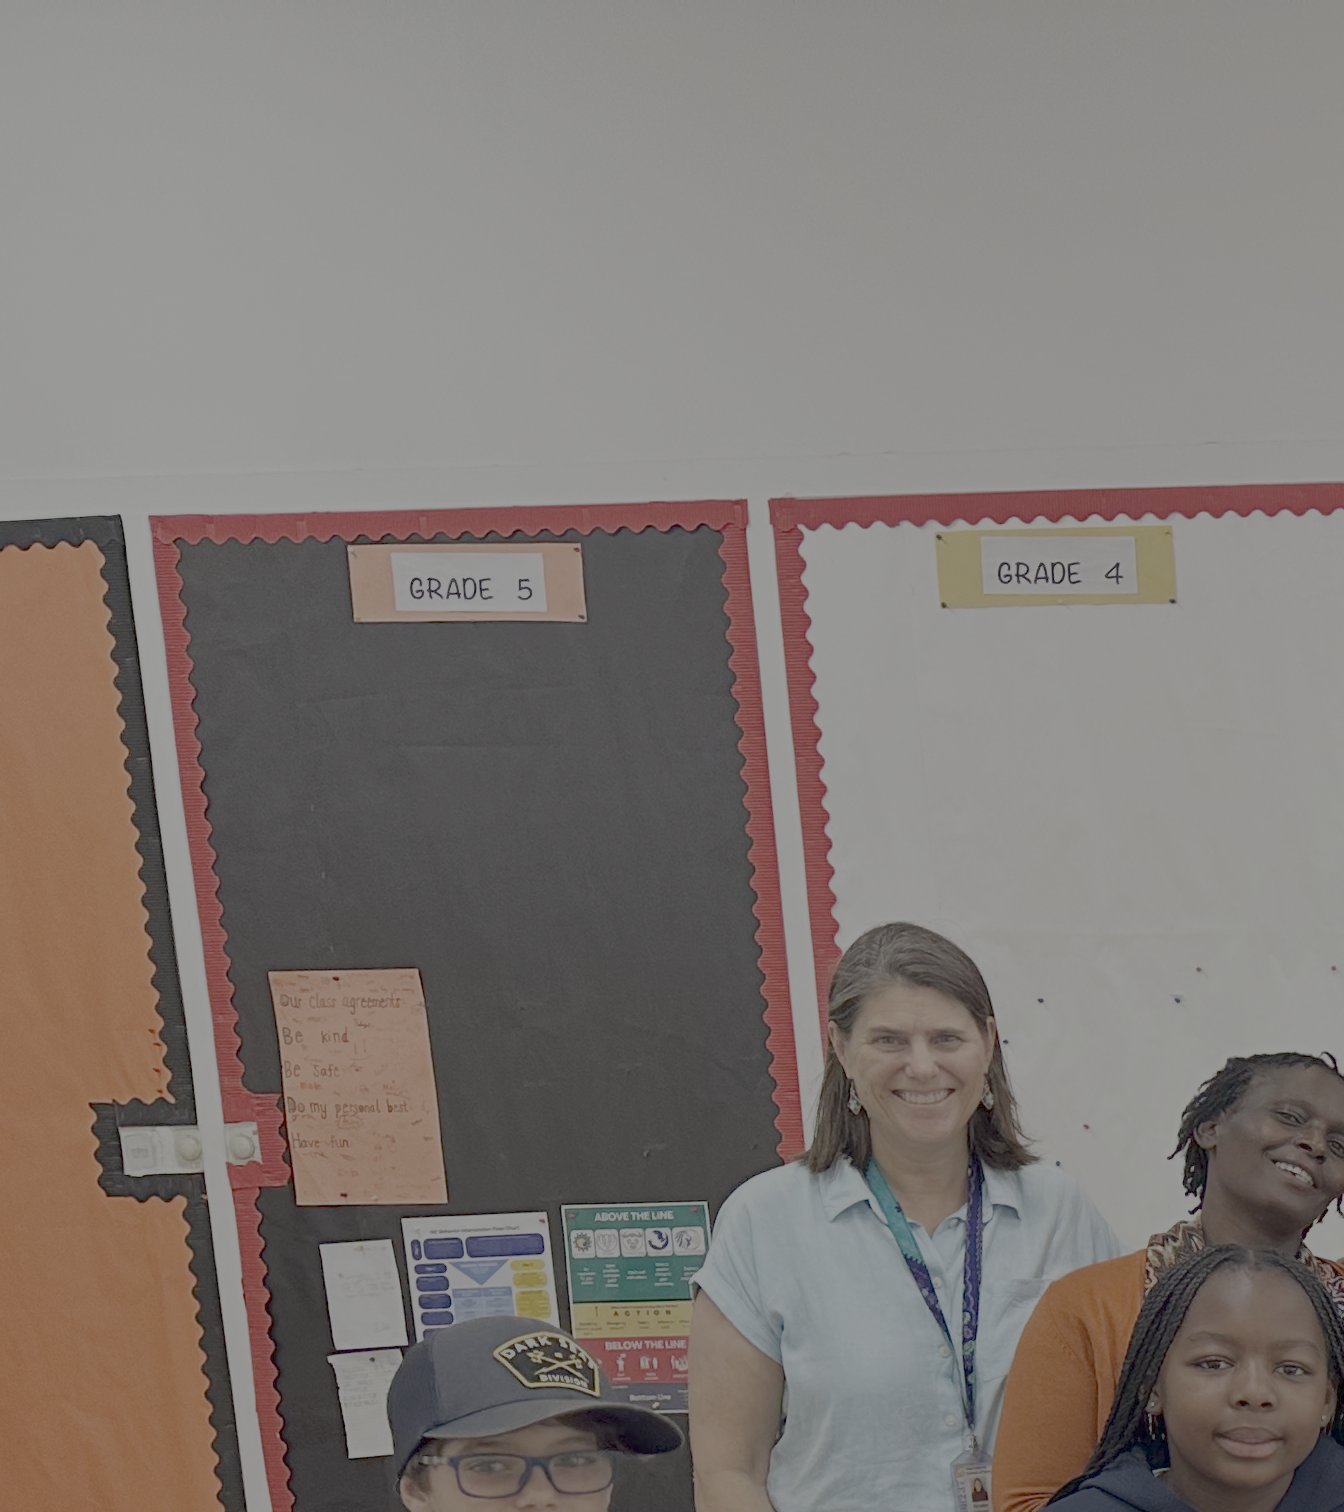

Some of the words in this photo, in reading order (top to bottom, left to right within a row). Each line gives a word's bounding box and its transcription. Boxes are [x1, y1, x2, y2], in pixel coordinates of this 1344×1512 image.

[997, 561, 1082, 585] GRADE
[1104, 562, 1124, 585] 4
[409, 577, 494, 601] GRADE
[517, 578, 533, 601] 5
[280, 994, 301, 1008] Our
[282, 1027, 303, 1045] Be
[321, 1027, 349, 1044] kind
[284, 1061, 301, 1078] Be
[287, 1097, 306, 1114] Do
[310, 1101, 327, 1119] my
[335, 1099, 381, 1119] personal
[386, 1098, 409, 1113] best
[291, 1132, 321, 1149] Have
[330, 1135, 350, 1148] fun
[594, 1211, 630, 1222] ABOVE
[631, 1210, 651, 1221] THE
[652, 1210, 675, 1221] LINE
[613, 1309, 672, 1317] ACTION
[500, 1336, 552, 1360] DARK
[605, 1341, 643, 1351] BELOW
[644, 1340, 665, 1350] THE
[665, 1339, 687, 1349] LINE
[539, 1374, 588, 1388] DIVISION
